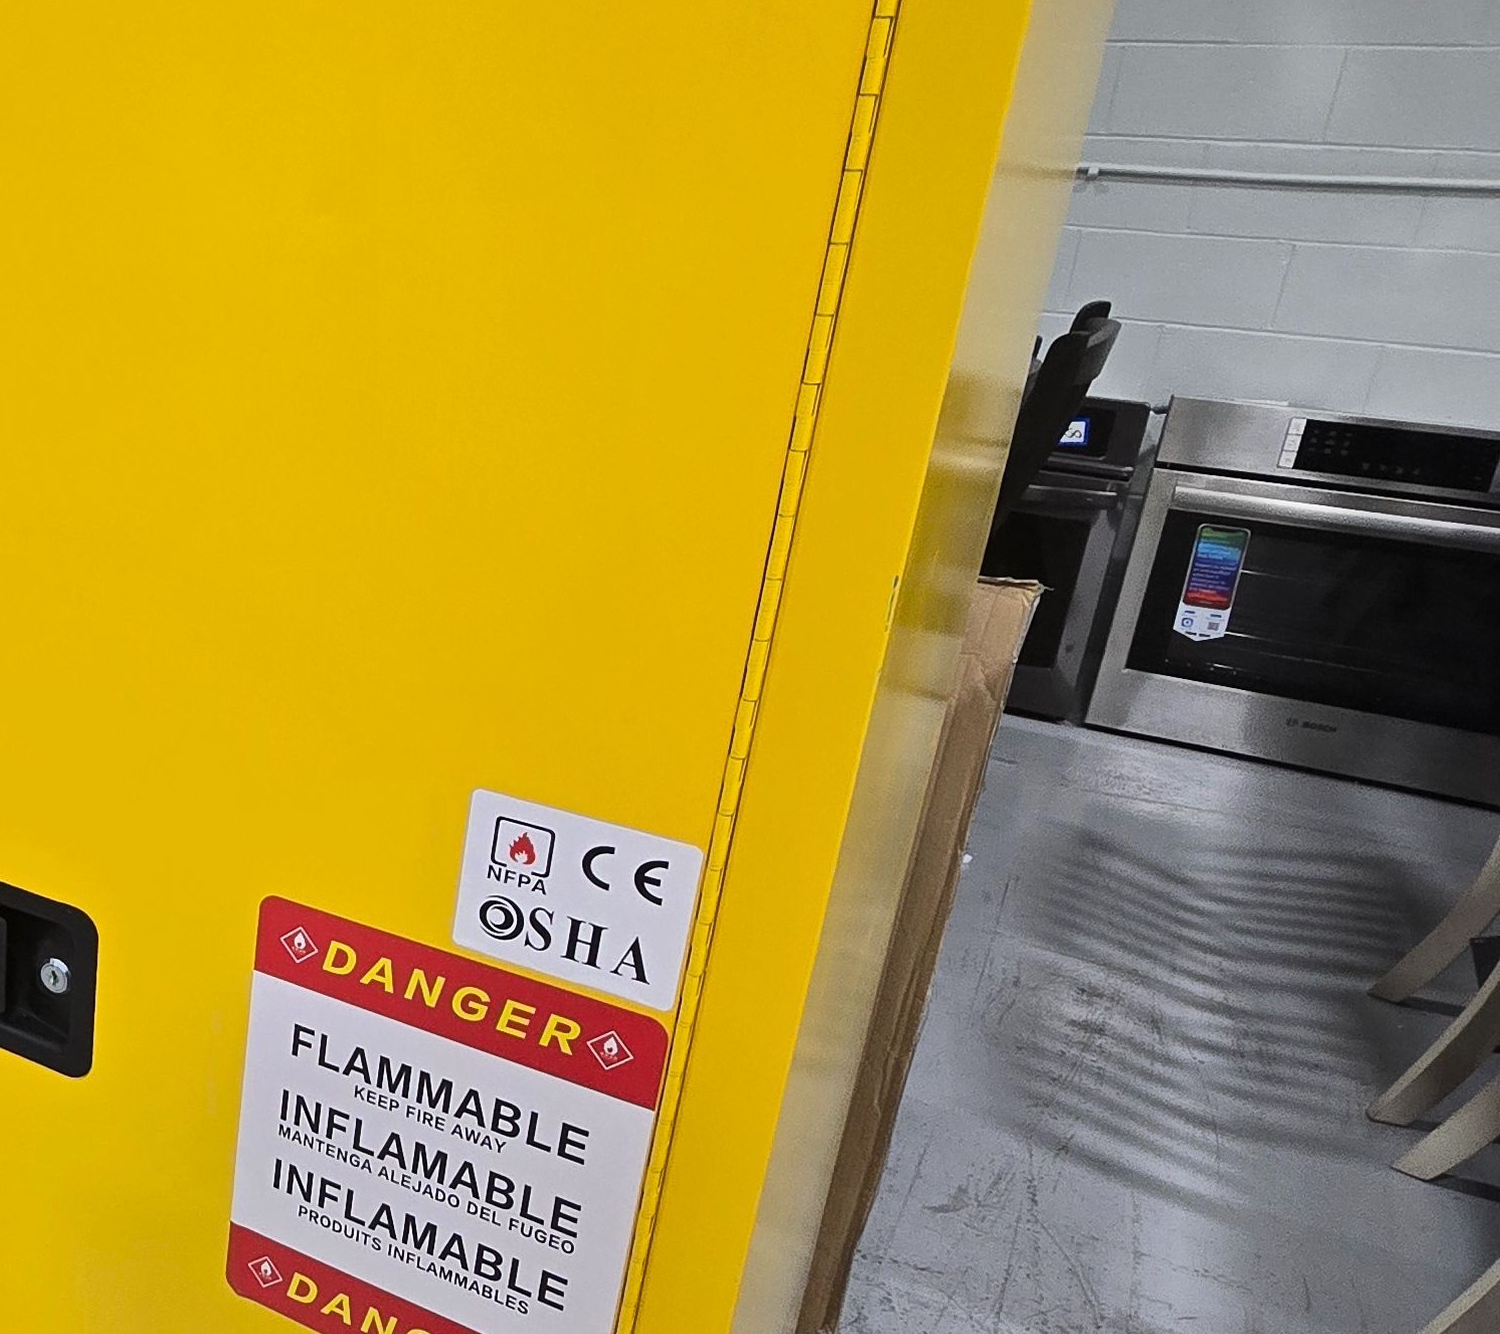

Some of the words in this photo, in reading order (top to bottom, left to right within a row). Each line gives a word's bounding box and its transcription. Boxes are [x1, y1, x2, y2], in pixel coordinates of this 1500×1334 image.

[487, 864, 547, 895] NFPA
[581, 845, 669, 906] CE
[479, 895, 650, 985] OSHA
[321, 939, 581, 1056] DANGER
[291, 1023, 590, 1165] FLAMMABLE
[354, 1085, 400, 1112] KEEP
[405, 1106, 446, 1132] FIRE
[451, 1124, 507, 1154] AWAY
[278, 1089, 582, 1239] INFLAMABLE
[278, 1124, 372, 1173] MANTENGA
[378, 1166, 460, 1208] ALEJADO
[466, 1201, 502, 1227] DEL
[508, 1219, 575, 1255] FUGEO
[272, 1158, 569, 1312] INFLAMABLE
[298, 1205, 382, 1252] PRODUITS
[388, 1243, 530, 1316] INFLAMMABLES
